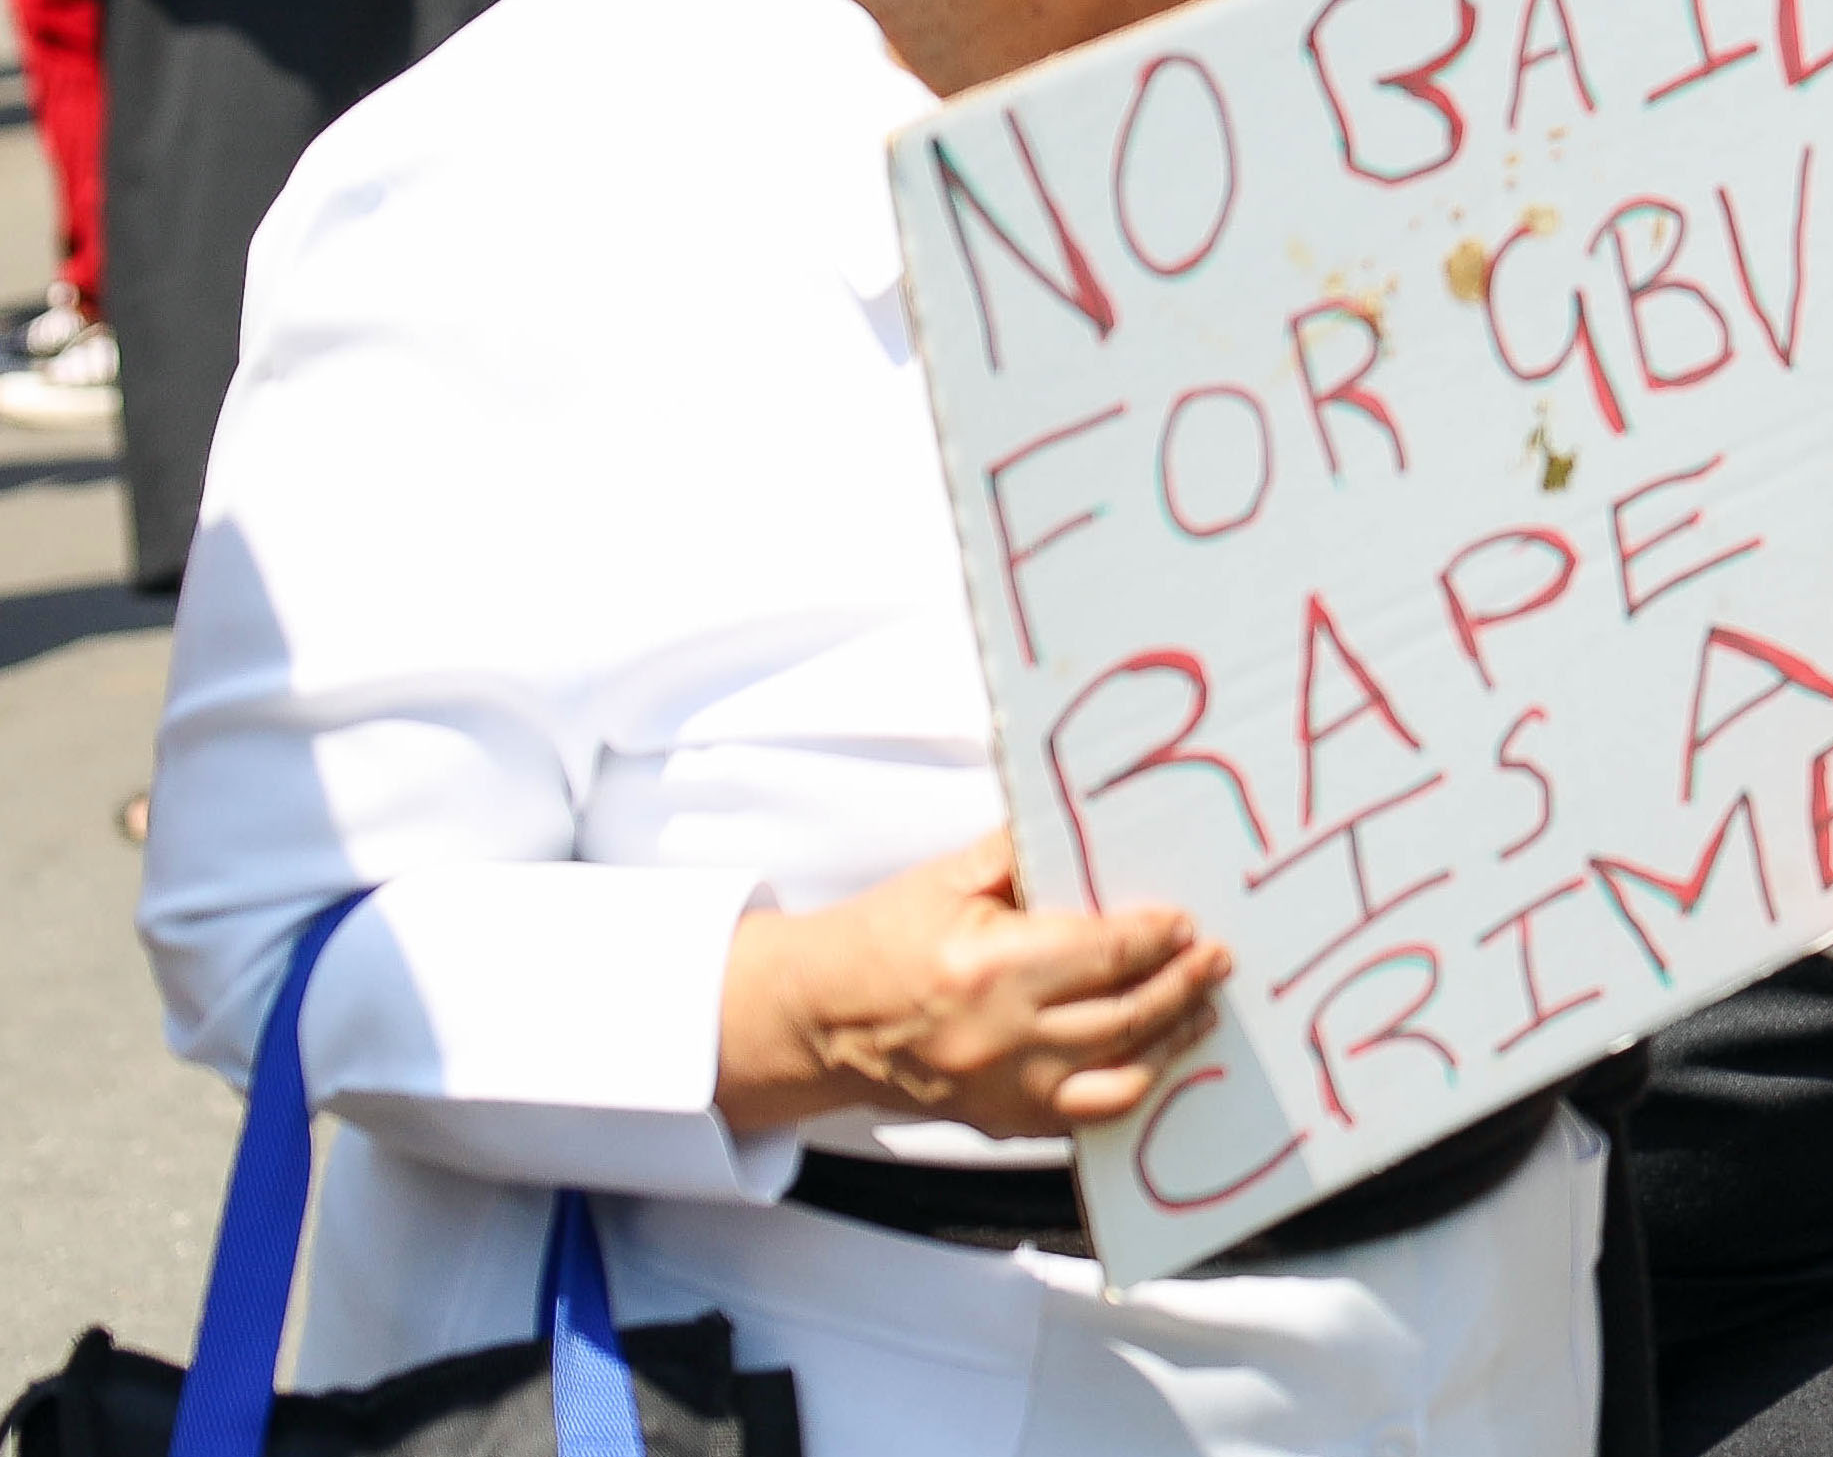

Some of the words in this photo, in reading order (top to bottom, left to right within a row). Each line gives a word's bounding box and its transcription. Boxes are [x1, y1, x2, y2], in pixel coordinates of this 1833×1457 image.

[930, 55, 1236, 373] NO
[986, 298, 1408, 666] FOR
[1484, 144, 1813, 432] GBV
[1048, 455, 1763, 916] RAPE
[1243, 708, 1550, 1002] IS
